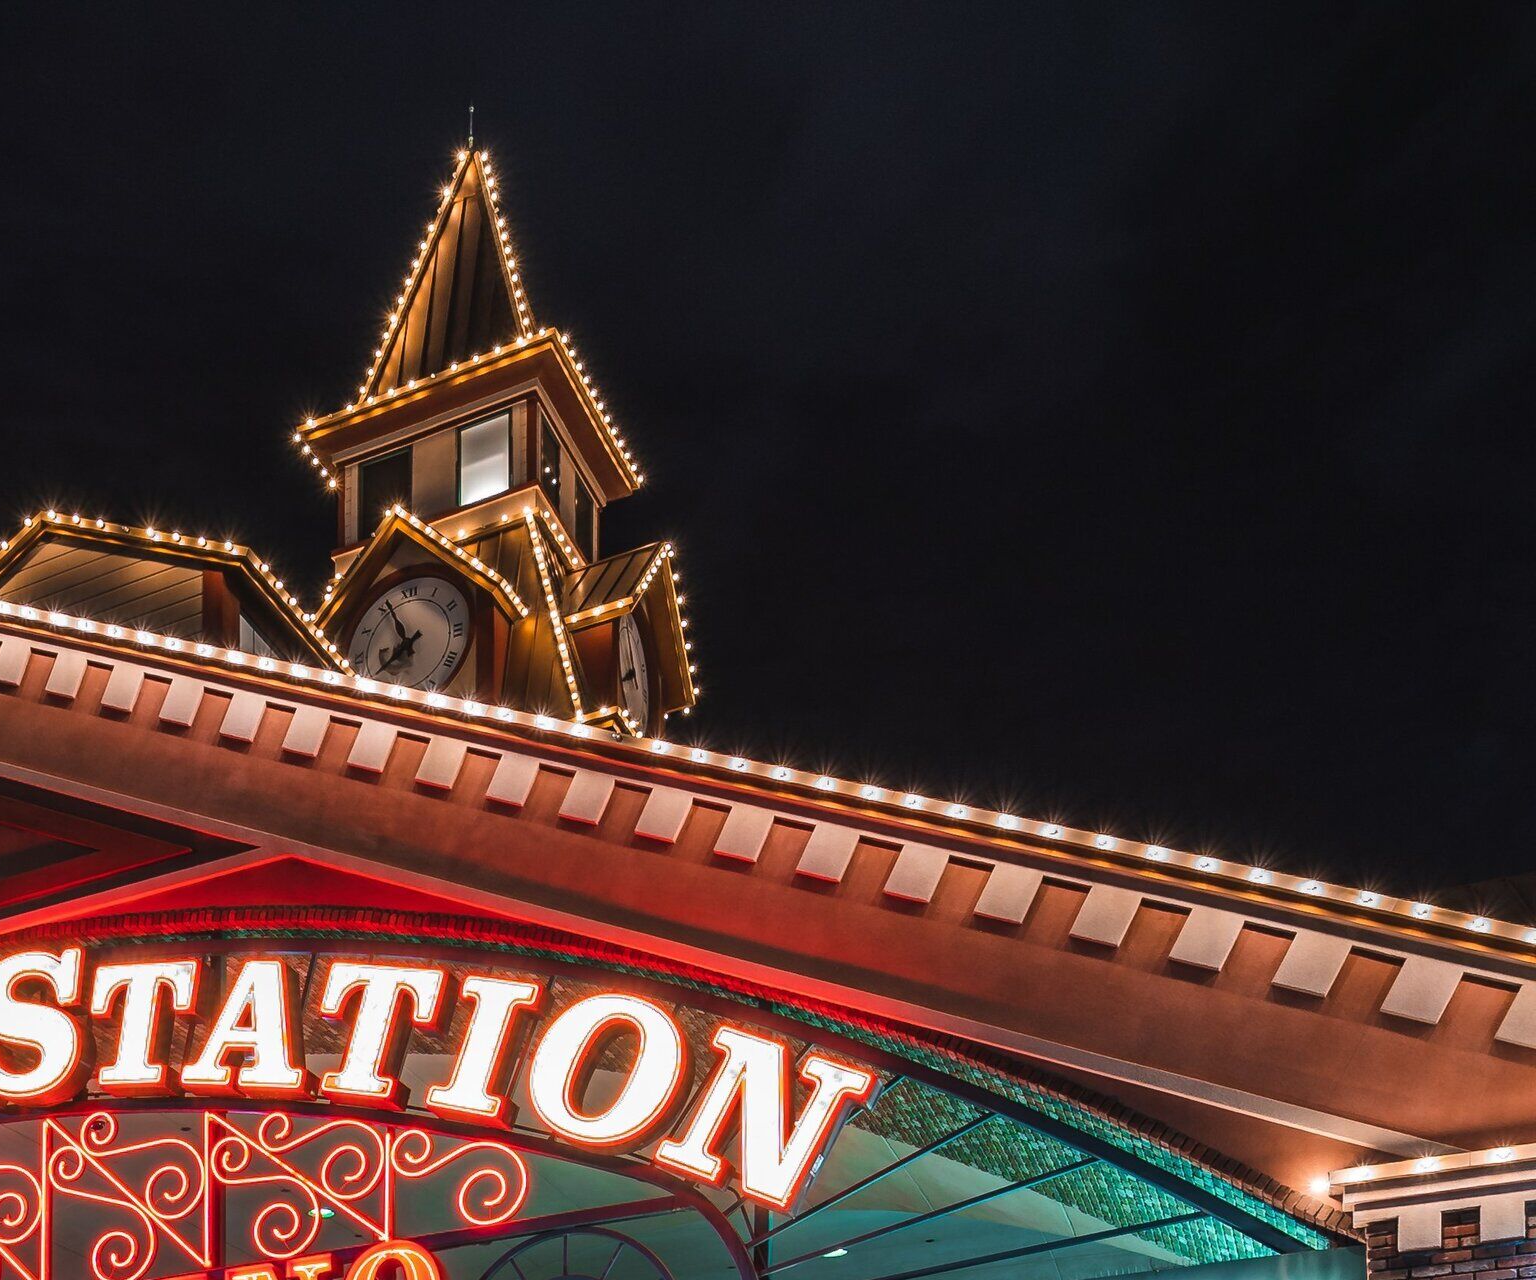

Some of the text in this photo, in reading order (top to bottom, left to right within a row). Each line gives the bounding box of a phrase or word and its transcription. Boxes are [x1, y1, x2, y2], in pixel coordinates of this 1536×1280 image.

[401, 586, 418, 600] XII
[431, 587, 438, 597] I
[446, 599, 458, 611] II
[453, 623, 463, 638] III
